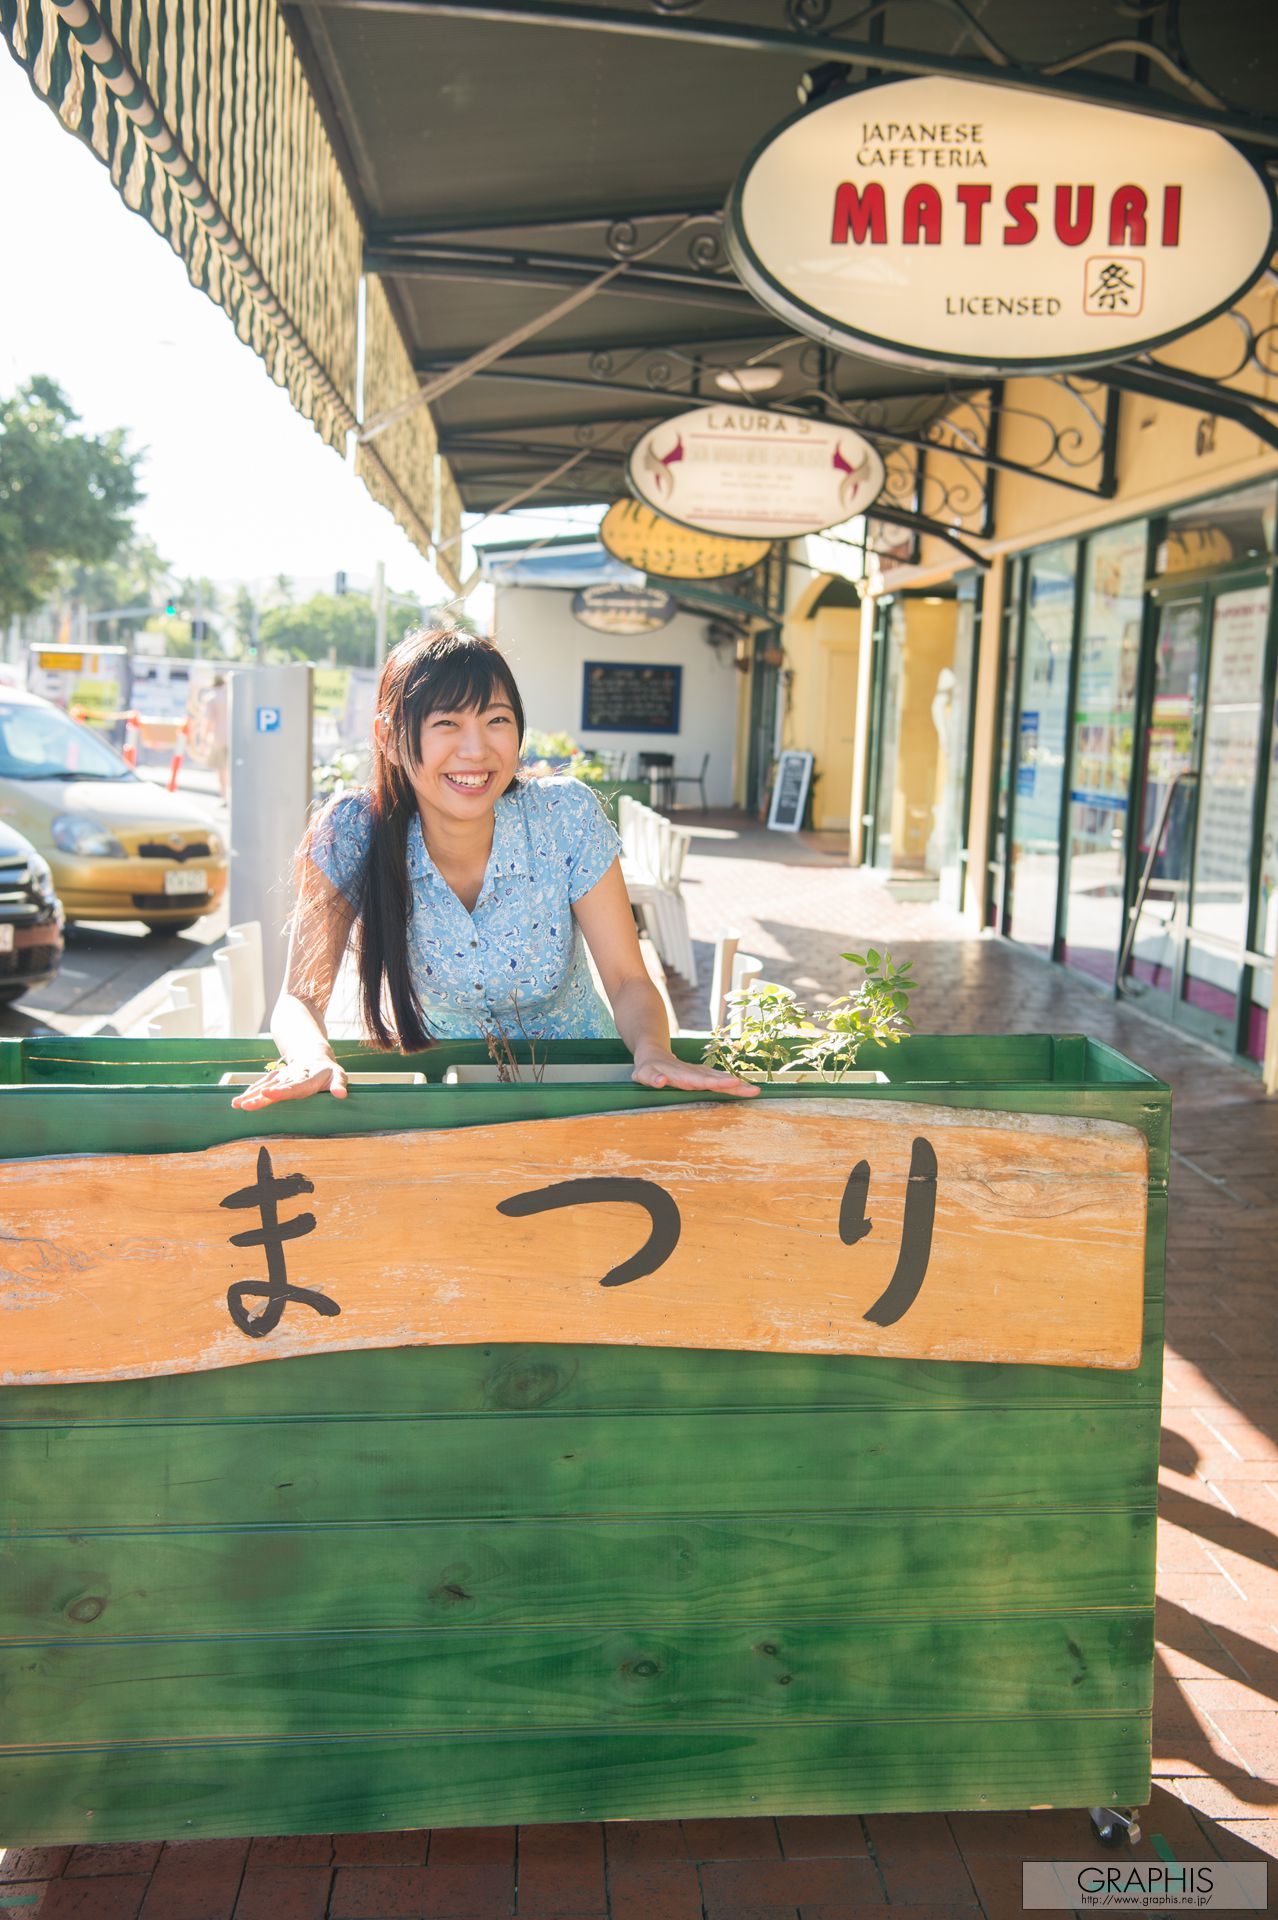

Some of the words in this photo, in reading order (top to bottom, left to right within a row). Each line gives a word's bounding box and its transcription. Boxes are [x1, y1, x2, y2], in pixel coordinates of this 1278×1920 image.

[861, 122, 984, 145] JAPANESE
[856, 147, 988, 169] CAFETERIA
[830, 181, 1183, 247] MATSURI
[1089, 262, 1136, 310] 祭
[945, 295, 1062, 317] LICENSED
[706, 412, 812, 434] LAURAS
[258, 710, 277, 731] P
[218, 1135, 939, 1339] まつり
